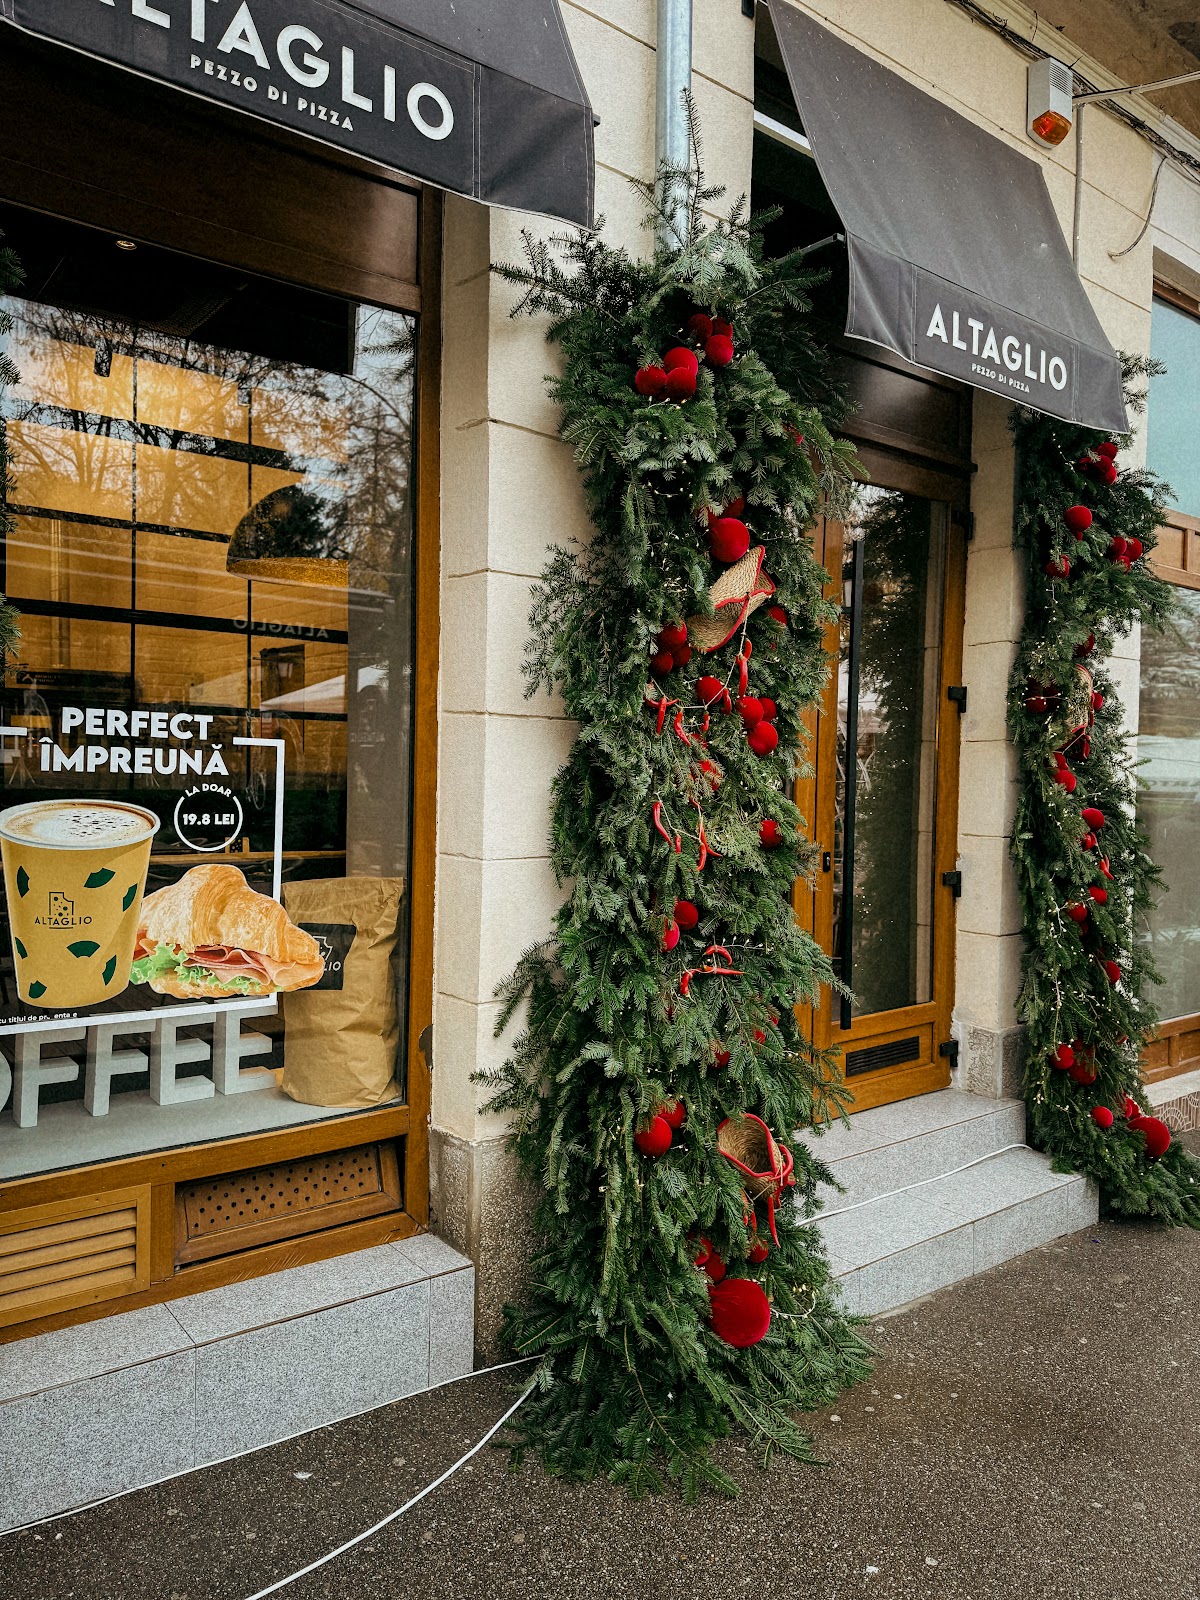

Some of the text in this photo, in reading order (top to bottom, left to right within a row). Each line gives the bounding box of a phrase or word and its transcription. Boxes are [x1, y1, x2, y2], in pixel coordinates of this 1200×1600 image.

[100, 0, 455, 141] LTAGLIO
[190, 54, 354, 132] PEZZO DI PIZZA
[926, 303, 1067, 391] ALTAGLIO
[971, 362, 1030, 393] PEZZO DI PIZZA
[61, 706, 214, 741] PERFECT
[38, 737, 229, 776] ÎMPREUNĂ
[185, 783, 232, 798] LA DOAR
[182, 813, 235, 826] 19.8 LEI
[34, 916, 93, 926] ALTAGLIO
